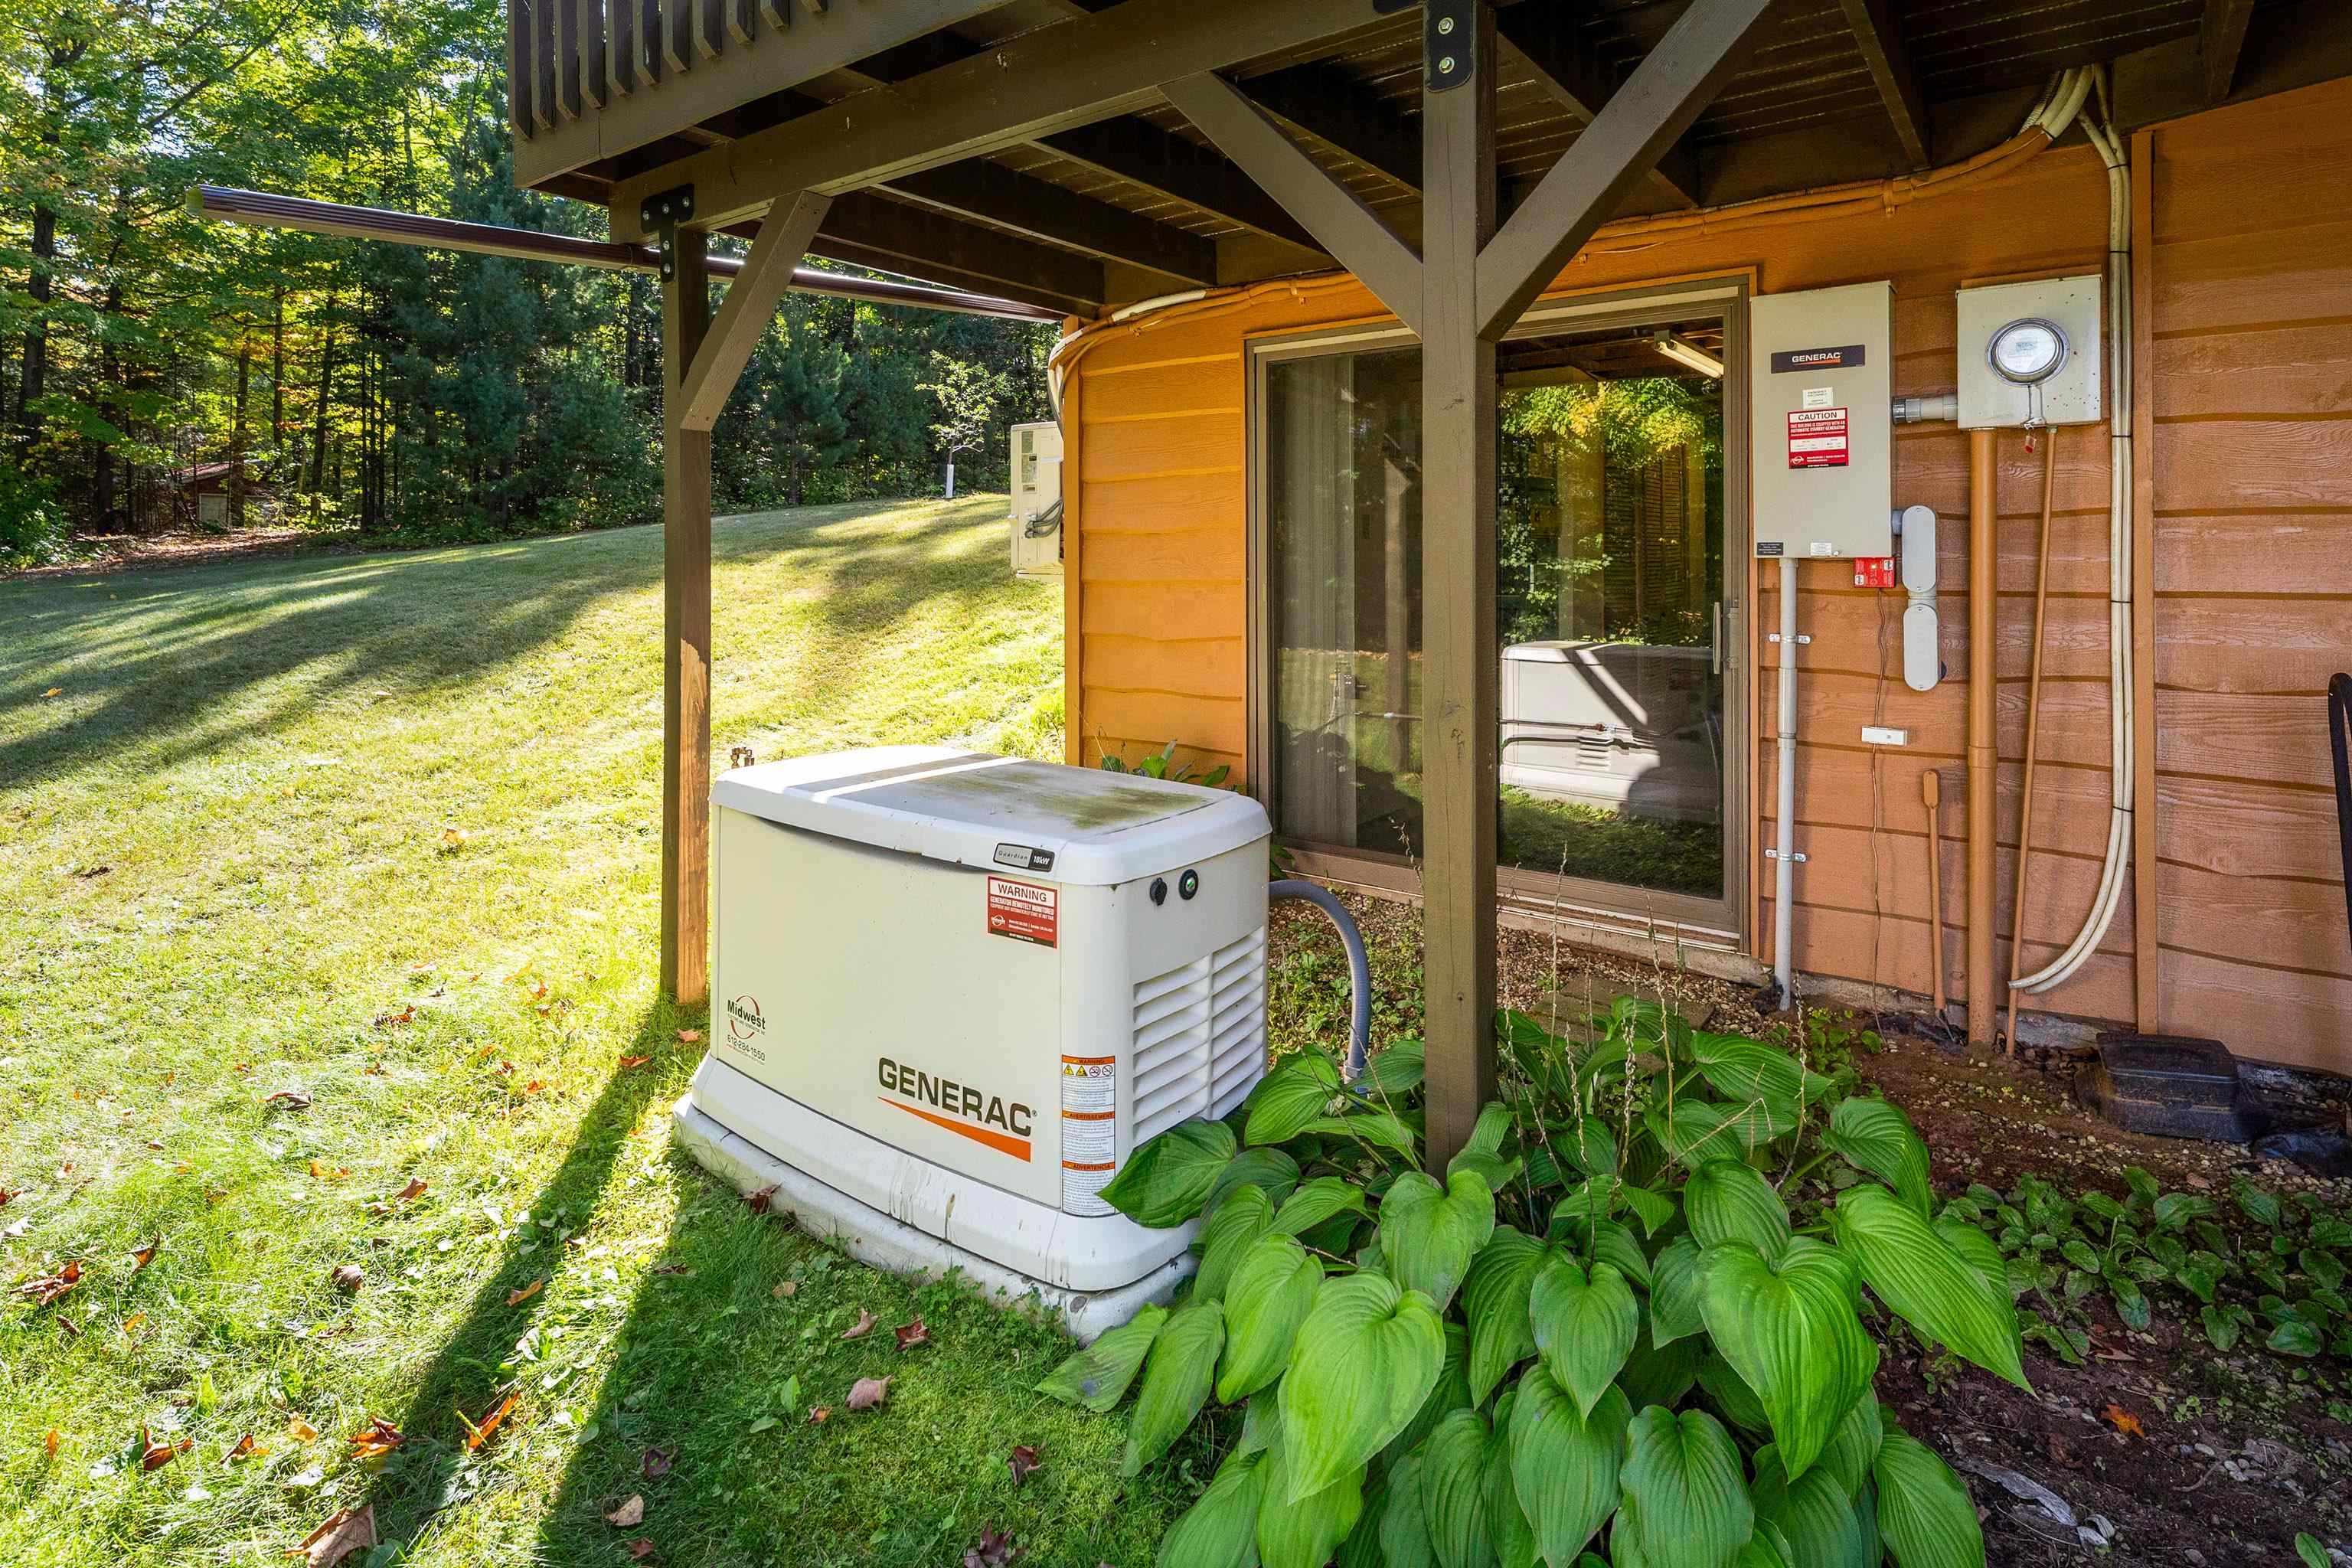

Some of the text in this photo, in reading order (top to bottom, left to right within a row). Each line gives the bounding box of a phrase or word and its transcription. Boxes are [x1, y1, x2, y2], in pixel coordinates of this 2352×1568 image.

[1792, 352, 1841, 362] GENERAC
[1798, 412, 1838, 420] CAUTION
[998, 851, 1027, 860] Guardian
[998, 883, 1047, 902] WARNING
[727, 999, 766, 1030] Midwest
[878, 1057, 1031, 1137] GENERAC
